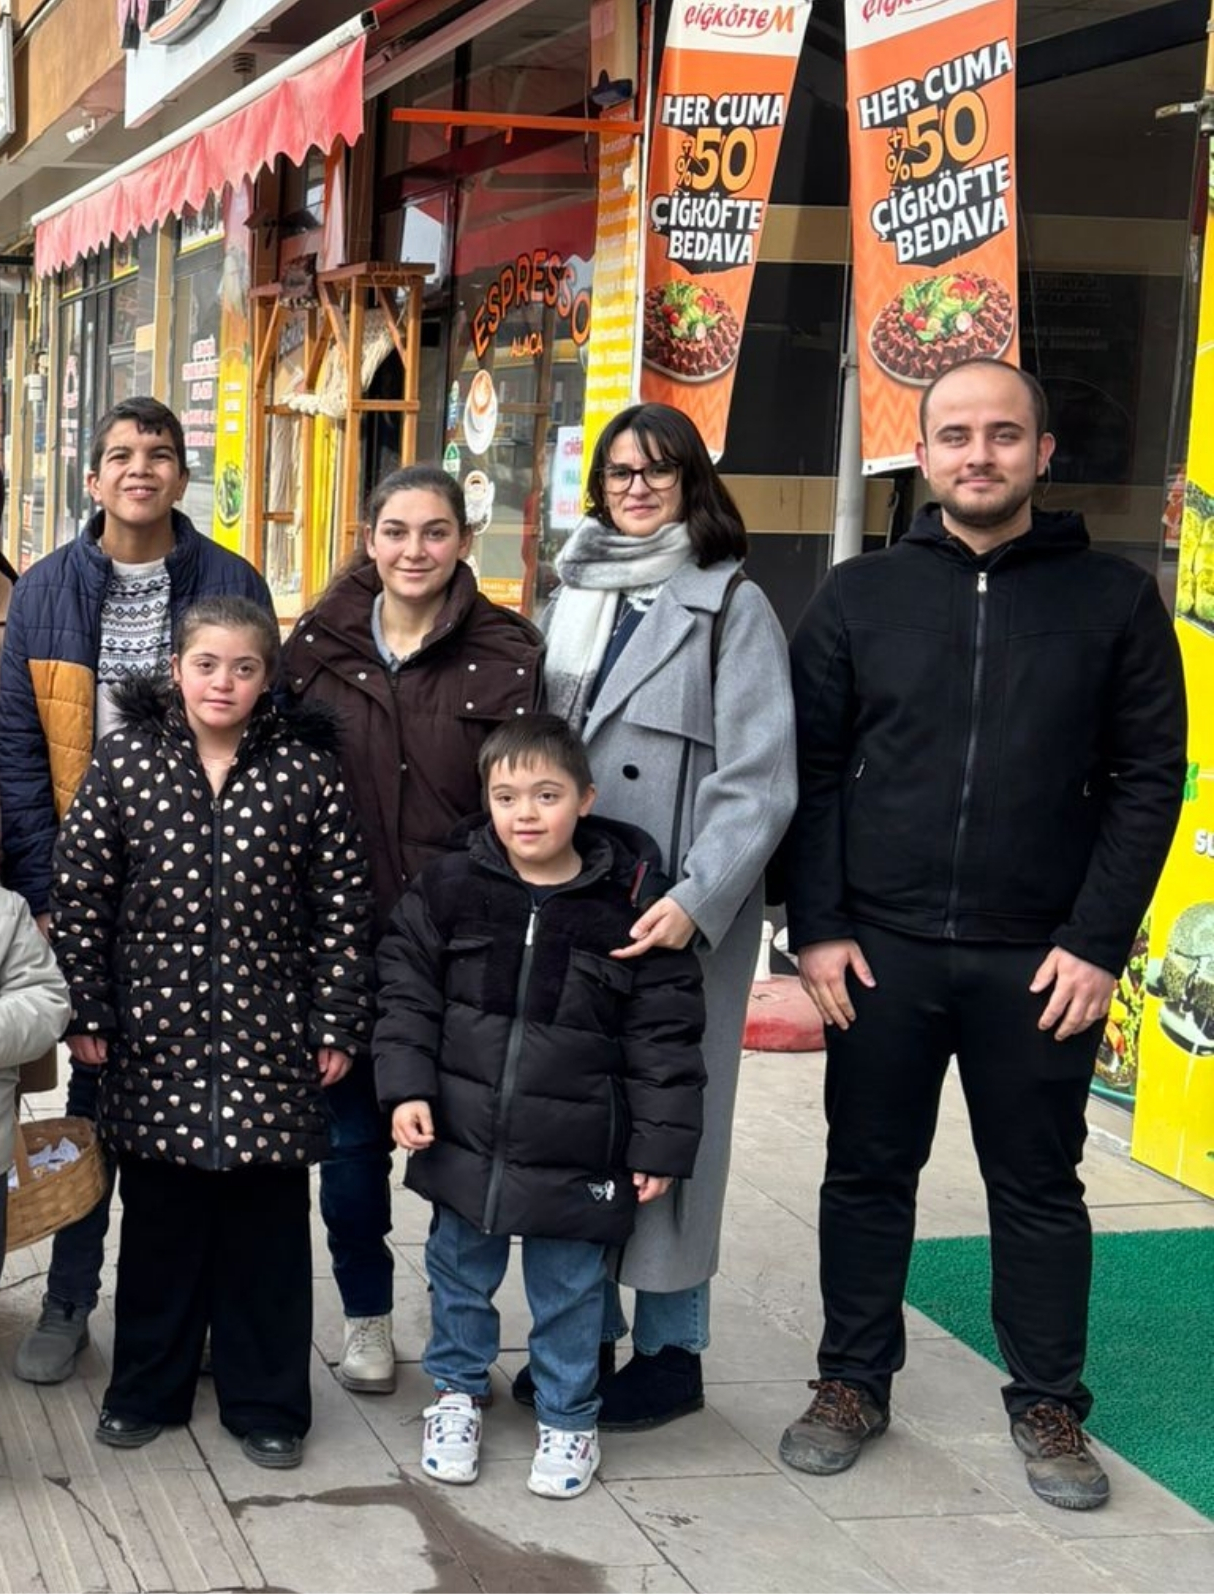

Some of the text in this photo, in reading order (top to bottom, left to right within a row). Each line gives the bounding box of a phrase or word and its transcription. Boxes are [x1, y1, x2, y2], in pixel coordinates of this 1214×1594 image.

[662, 94, 785, 126] HER CUMA
[859, 39, 1013, 129] HER CUMA
[651, 191, 765, 232] ÇİĞKÖFTE
[872, 156, 1011, 241] ÇİĞKÖFTE
[896, 197, 1009, 263] BEDAVA
[668, 230, 754, 264] BEDAVA
[472, 249, 591, 358] ESPRESSO
